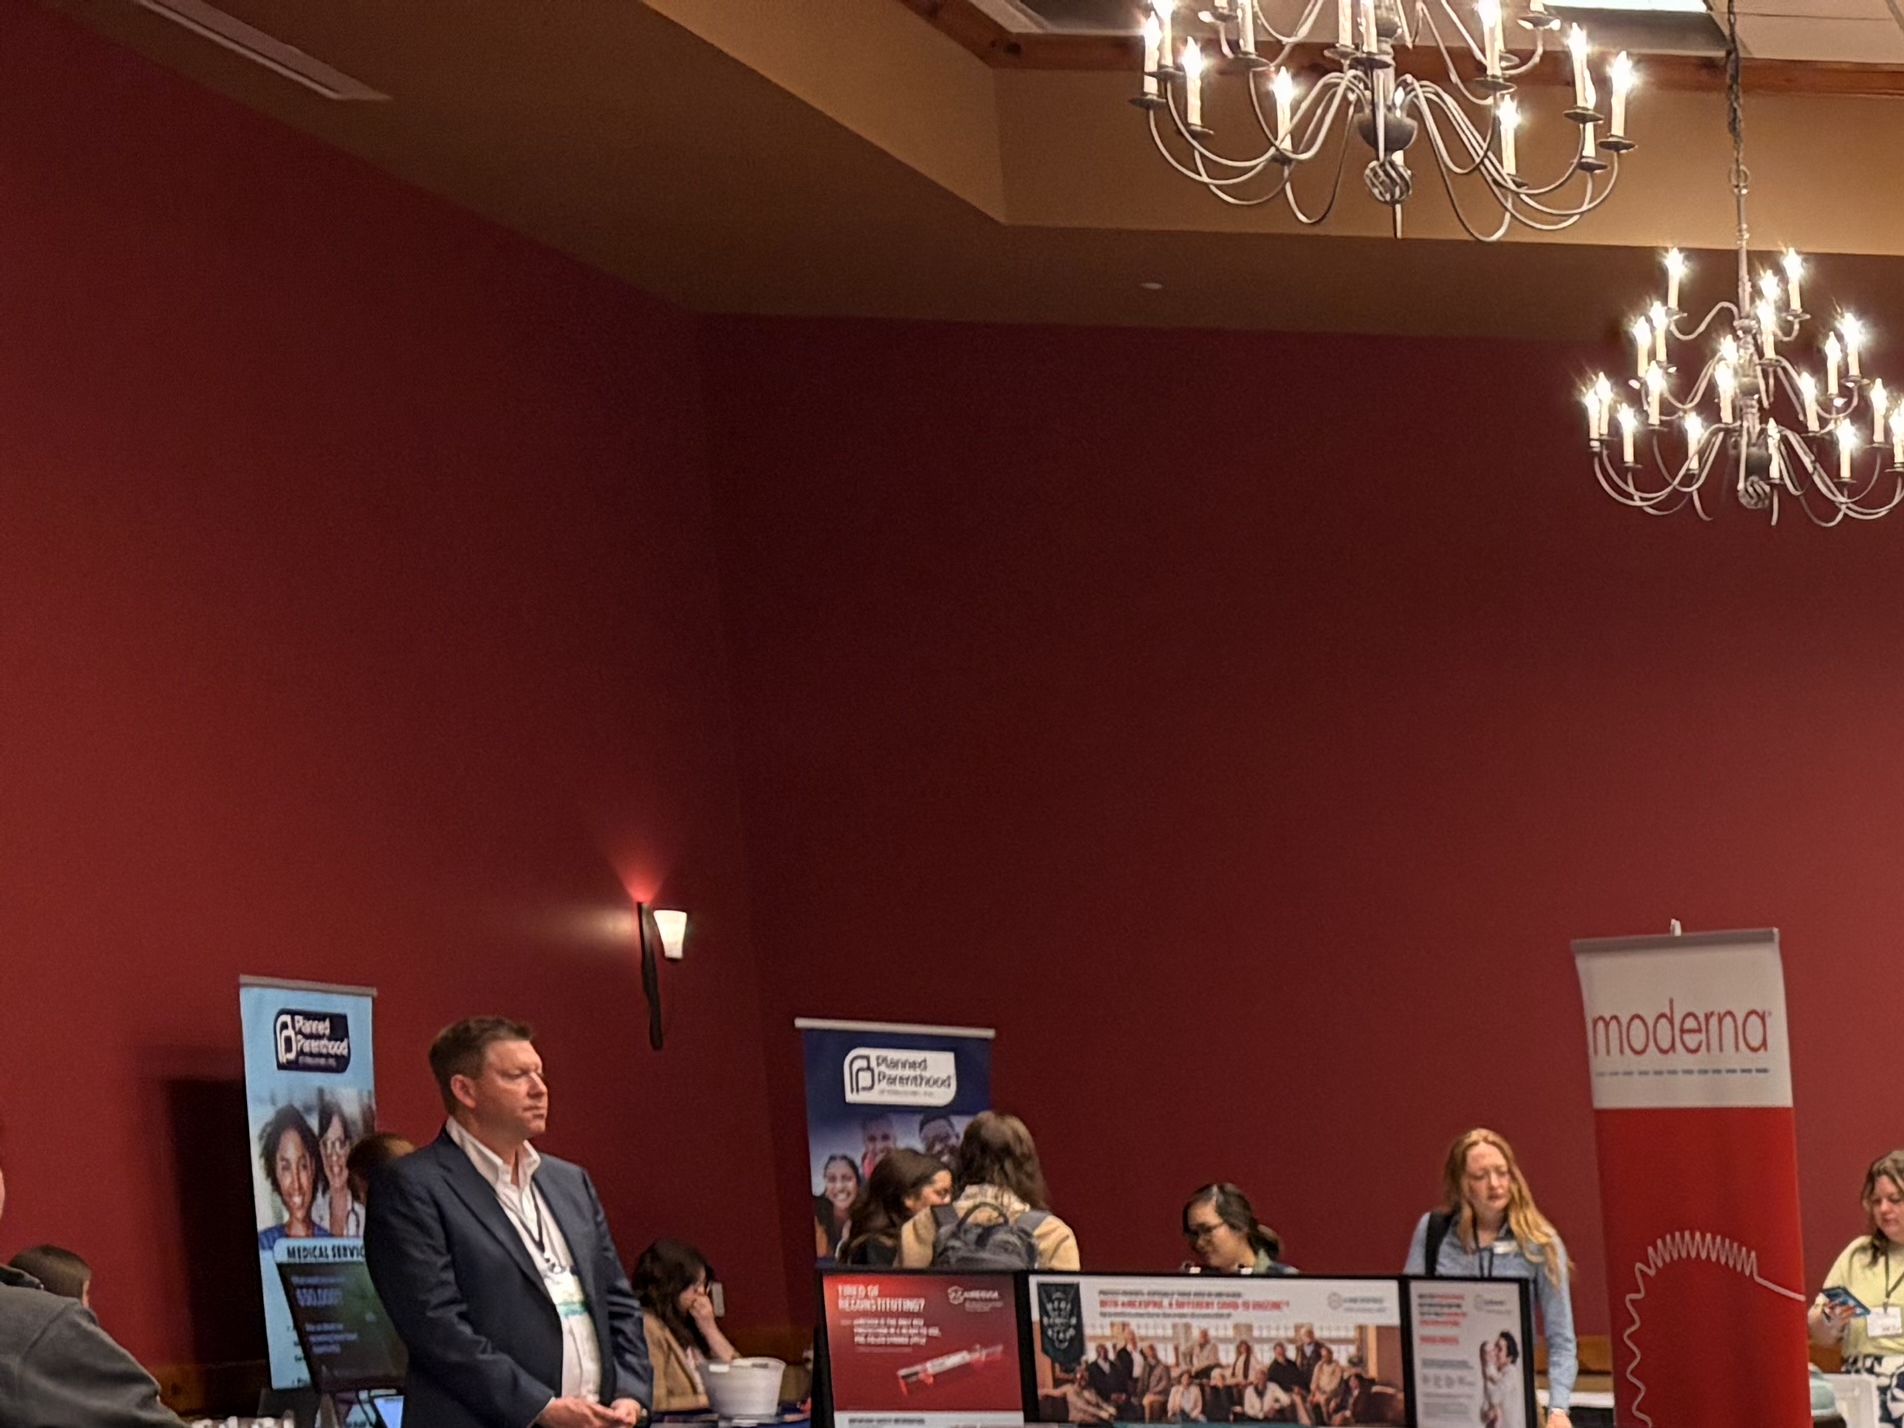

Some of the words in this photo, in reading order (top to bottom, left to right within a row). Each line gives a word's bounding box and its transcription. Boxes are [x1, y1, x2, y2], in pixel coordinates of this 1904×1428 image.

[295, 1017, 330, 1037] Planned
[1591, 997, 1771, 1056] moderna
[296, 1034, 348, 1058] Parenthood
[875, 1054, 929, 1074] Planned
[876, 1071, 953, 1091] Parenthood
[286, 1244, 329, 1260] MEDICAL
[331, 1244, 365, 1259] SERVIC
